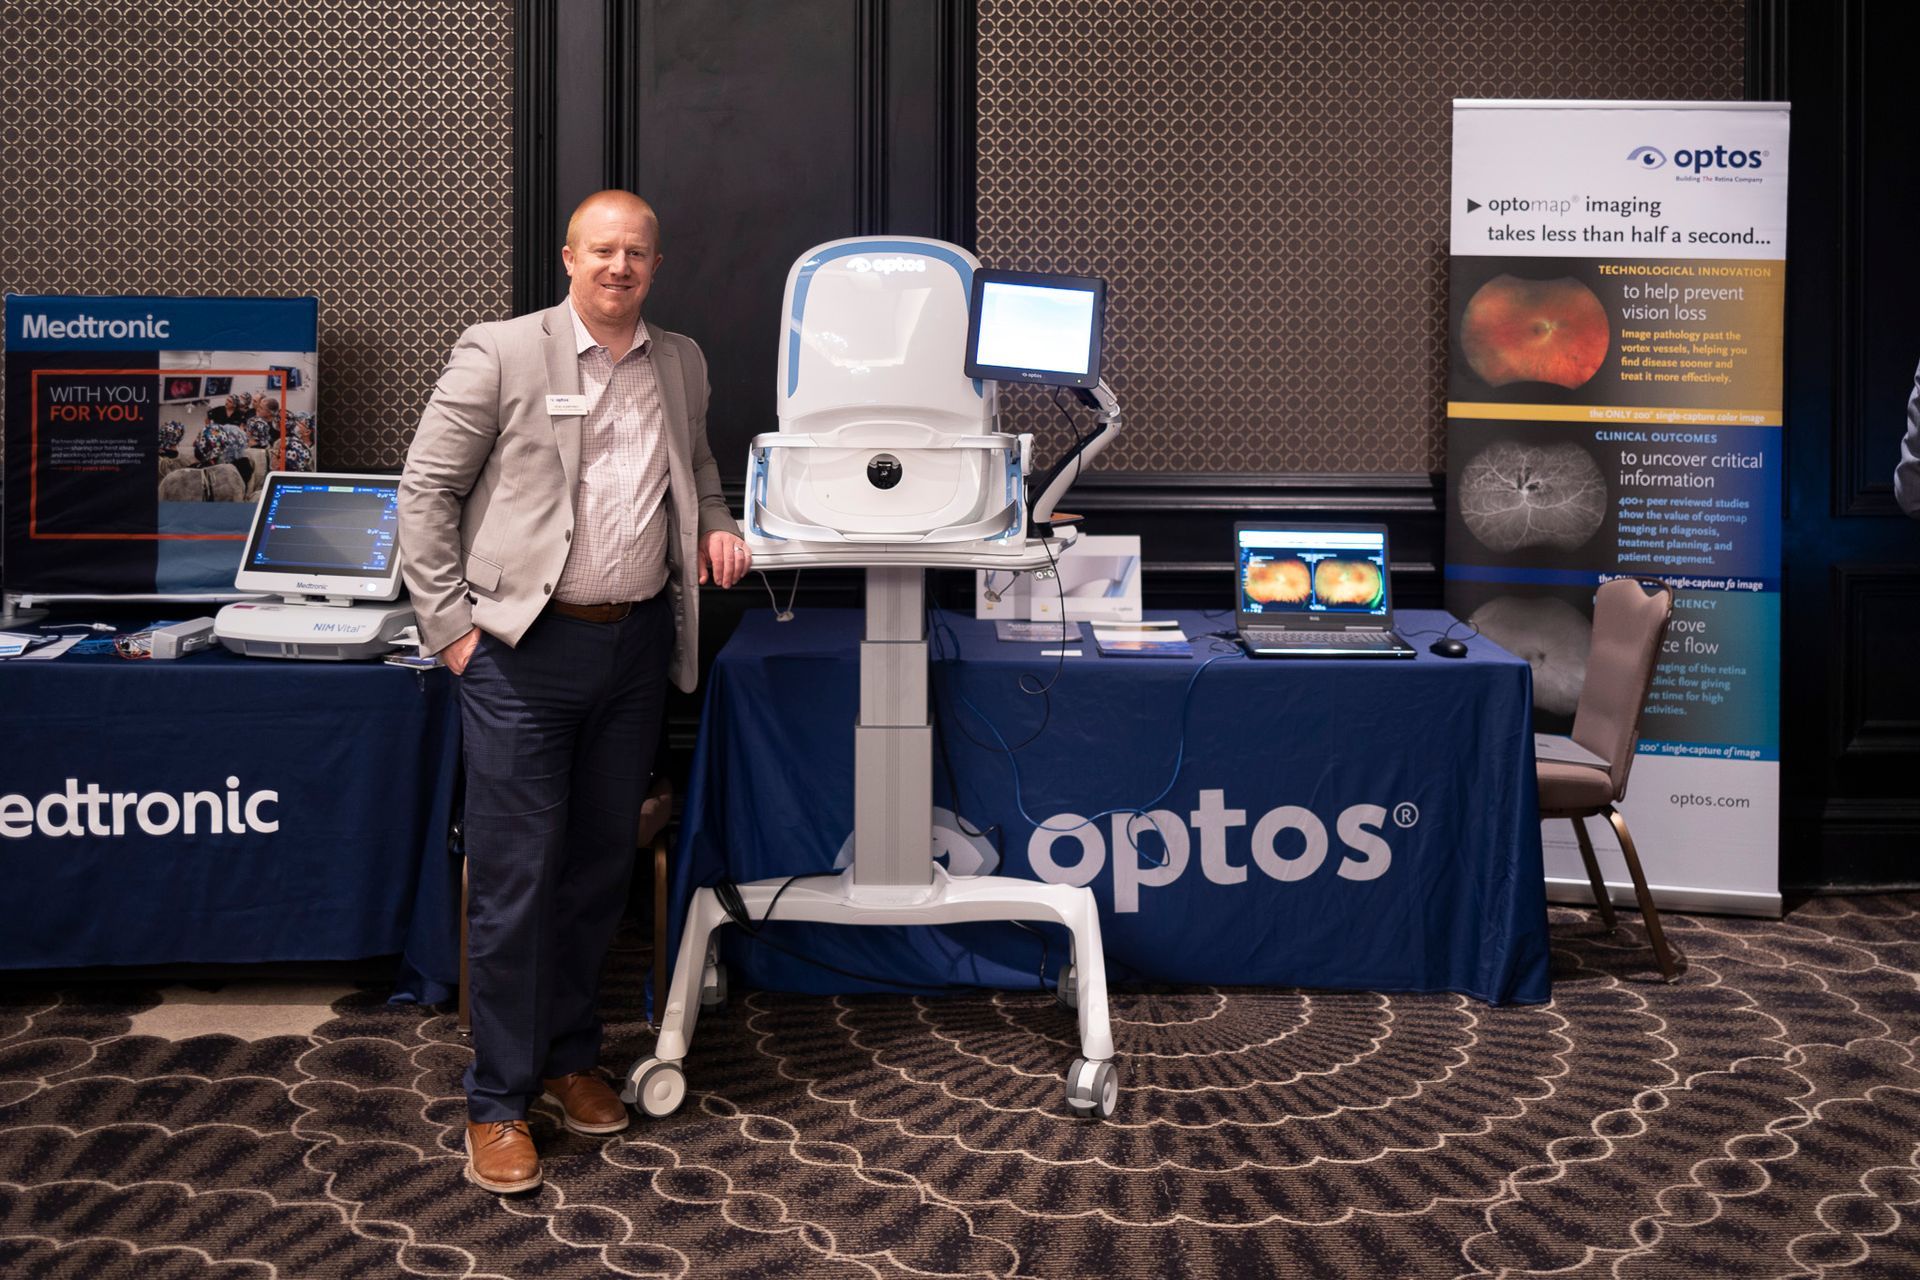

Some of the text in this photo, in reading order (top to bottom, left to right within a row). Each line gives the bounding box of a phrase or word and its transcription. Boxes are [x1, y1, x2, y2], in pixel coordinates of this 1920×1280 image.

[1586, 196, 1661, 217] imaging
[1489, 226, 1771, 245] takes less than half a second...
[872, 257, 926, 275] optos
[1599, 265, 1771, 277] TECHNOLOGICAL INNOVATION
[1624, 283, 1744, 303] to help prevent
[1623, 304, 1707, 321] vision loss
[22, 315, 169, 338] Medtronic
[1622, 330, 1741, 341] Image pathology past the
[1621, 344, 1747, 356] vortex vessels, helping you
[1621, 357, 1733, 368] find disease sooner and
[1621, 371, 1731, 384] treat it more effectively.
[50, 387, 150, 404] WITH YOU,
[50, 406, 143, 422] FOR YOU.
[1590, 410, 1603, 419] the
[1605, 410, 1631, 420] ONLY
[1656, 411, 1715, 423] single-capture
[1717, 413, 1738, 423] color
[1740, 414, 1764, 424] image
[1596, 432, 1717, 443] CLINICAL OUTCOMES
[1621, 452, 1762, 469] to uncover critical
[1620, 471, 1714, 488] information
[1619, 497, 1749, 509] 400+ peer reviewed studies
[1618, 510, 1747, 525] show the value of optomap
[1619, 523, 1719, 537] imaging in diagnosis,
[1618, 539, 1732, 552] treatment planning, and
[1618, 552, 1715, 565] patient engagement.
[1665, 577, 1725, 590] single-capture
[1725, 579, 1735, 590] fa
[1737, 581, 1763, 591] image
[1674, 599, 1717, 609] CIENCY
[313, 623, 336, 632] NIM
[1685, 636, 1719, 655] flow
[1657, 663, 1746, 675] aging of the retina
[1679, 677, 1699, 687] flow
[1701, 679, 1730, 691] giving
[1662, 690, 1683, 701] time
[1686, 691, 1699, 701] for
[1702, 692, 1723, 704] high
[1662, 744, 1720, 756] single-capture
[1734, 747, 1760, 759] image
[0, 775, 279, 838] edtronic
[1671, 792, 1750, 809] optos.com
